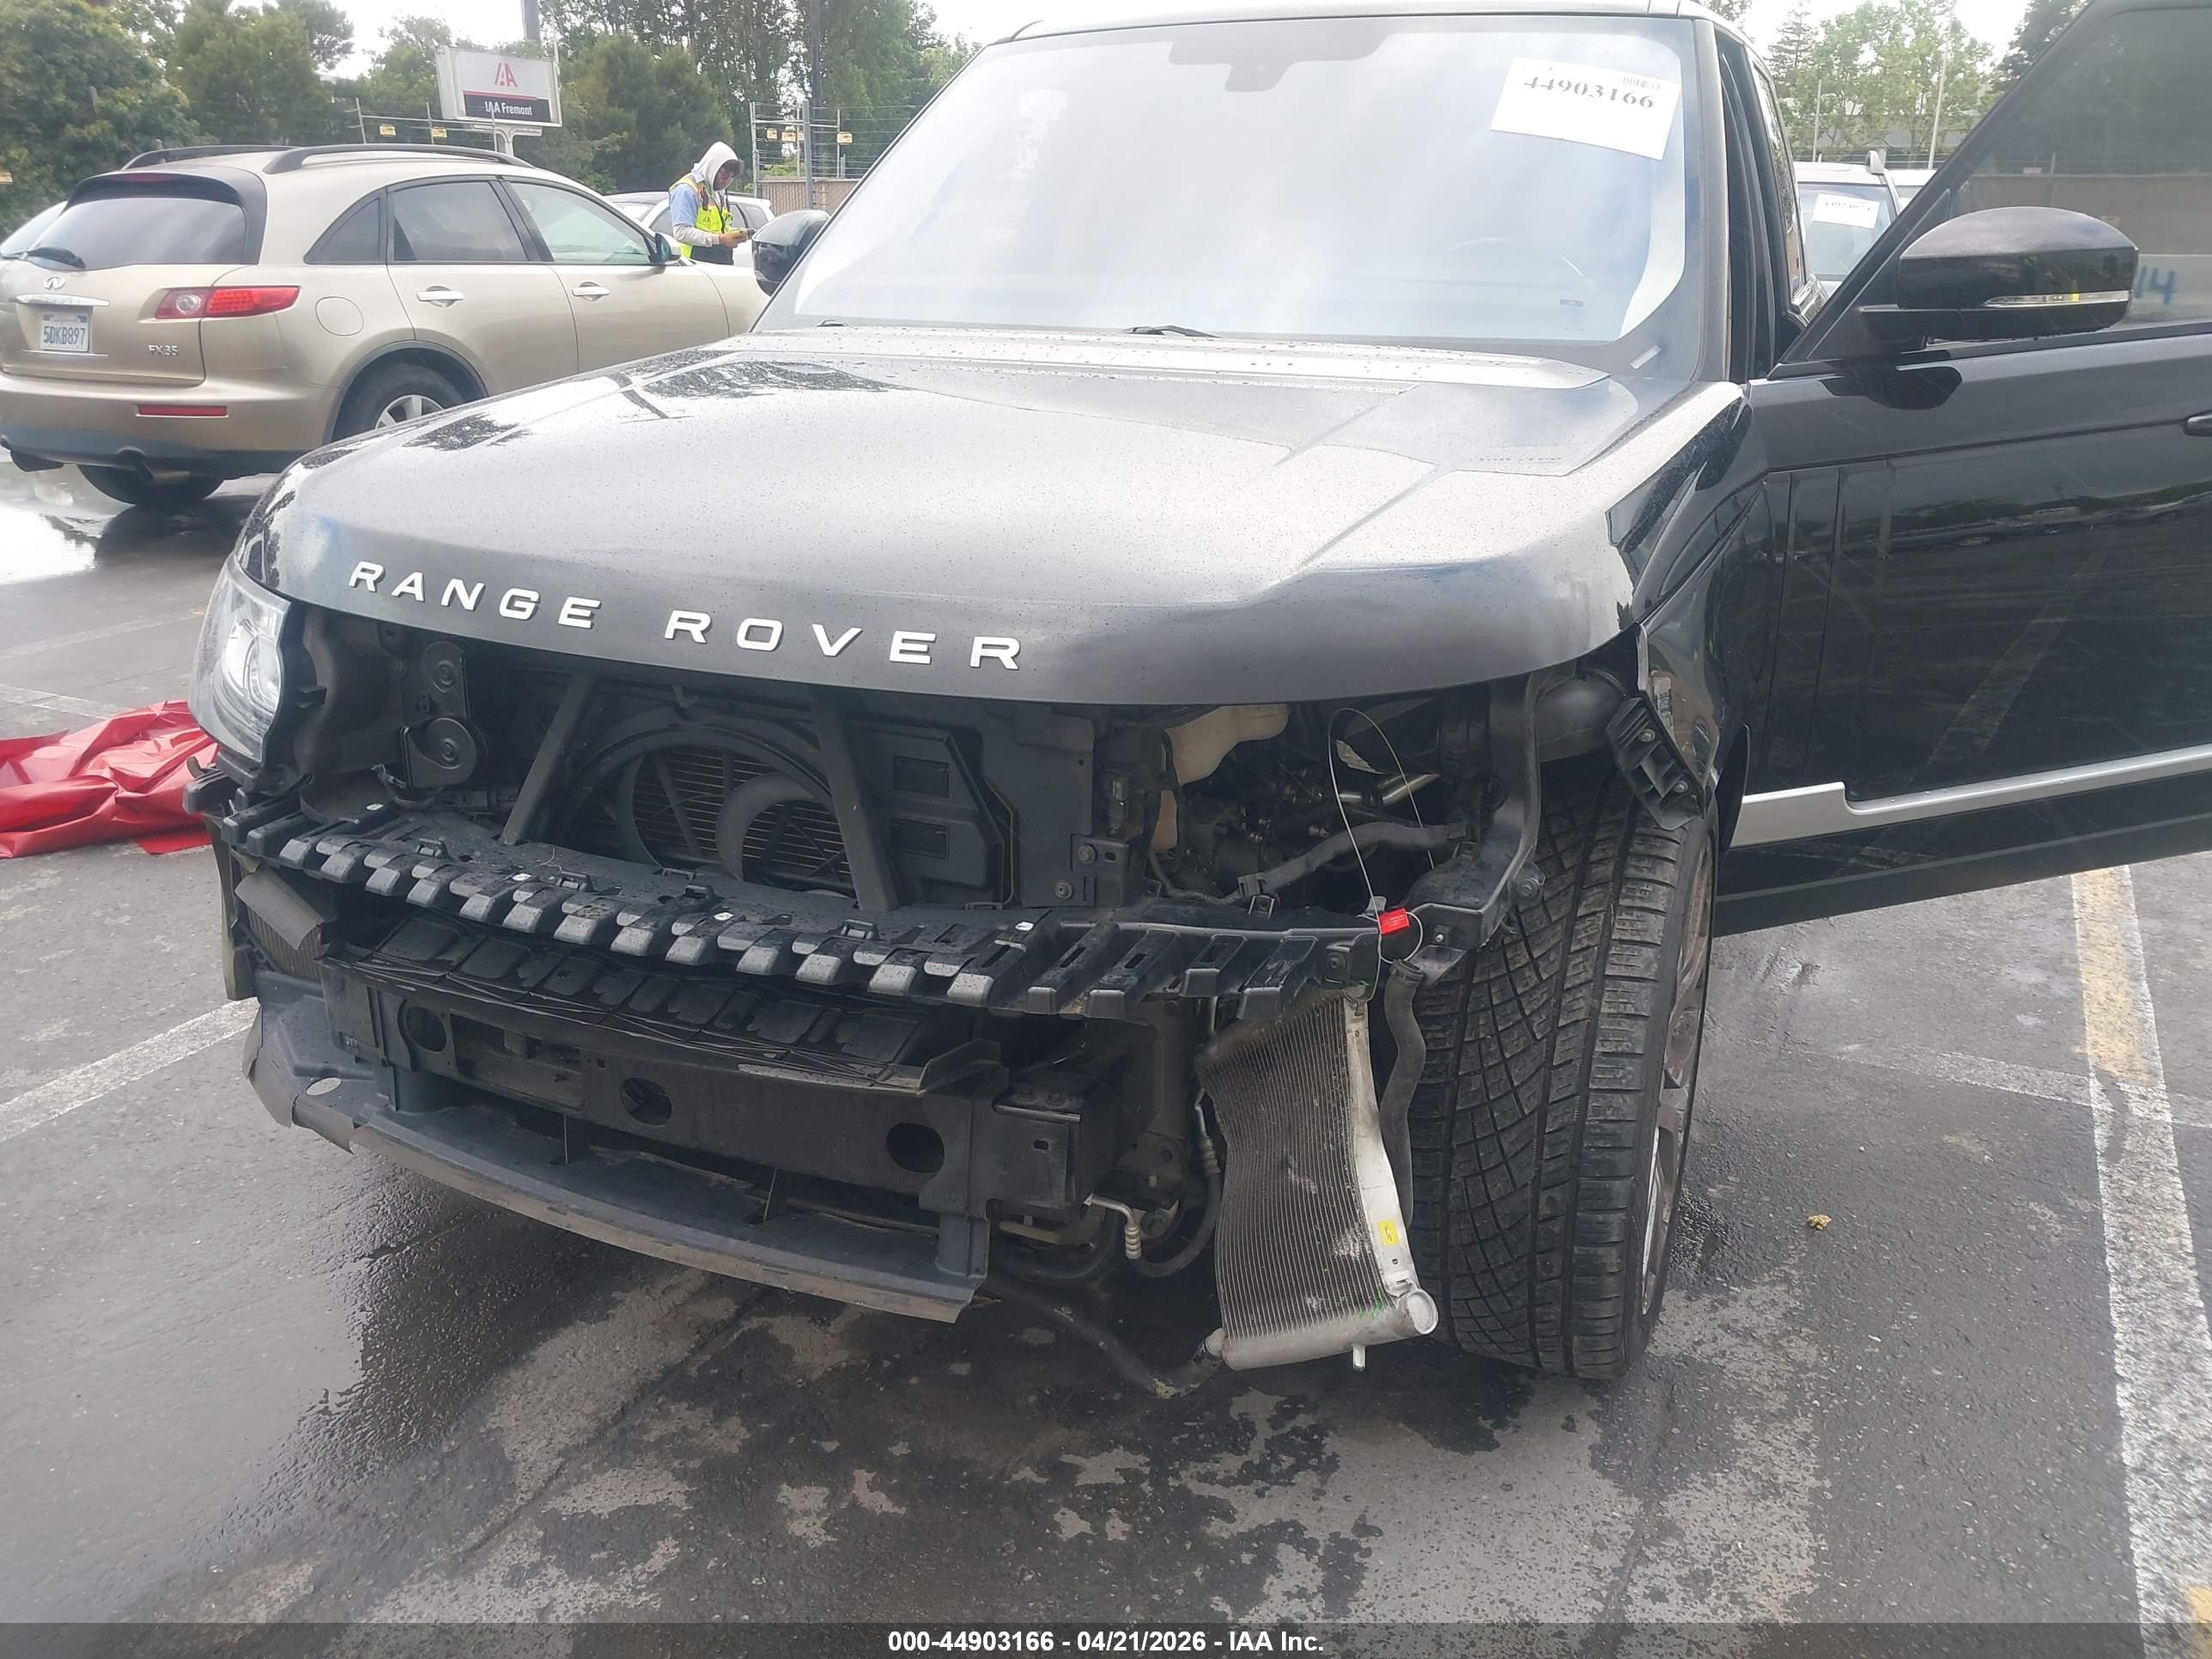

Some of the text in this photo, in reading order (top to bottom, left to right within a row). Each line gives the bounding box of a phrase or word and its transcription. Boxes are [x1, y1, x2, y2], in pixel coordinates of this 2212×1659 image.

[484, 100, 532, 117] IAA Fremont
[43, 325, 86, 346] 5DKB897
[148, 344, 179, 356] FX35
[348, 561, 1022, 671] RANGE ROVER
